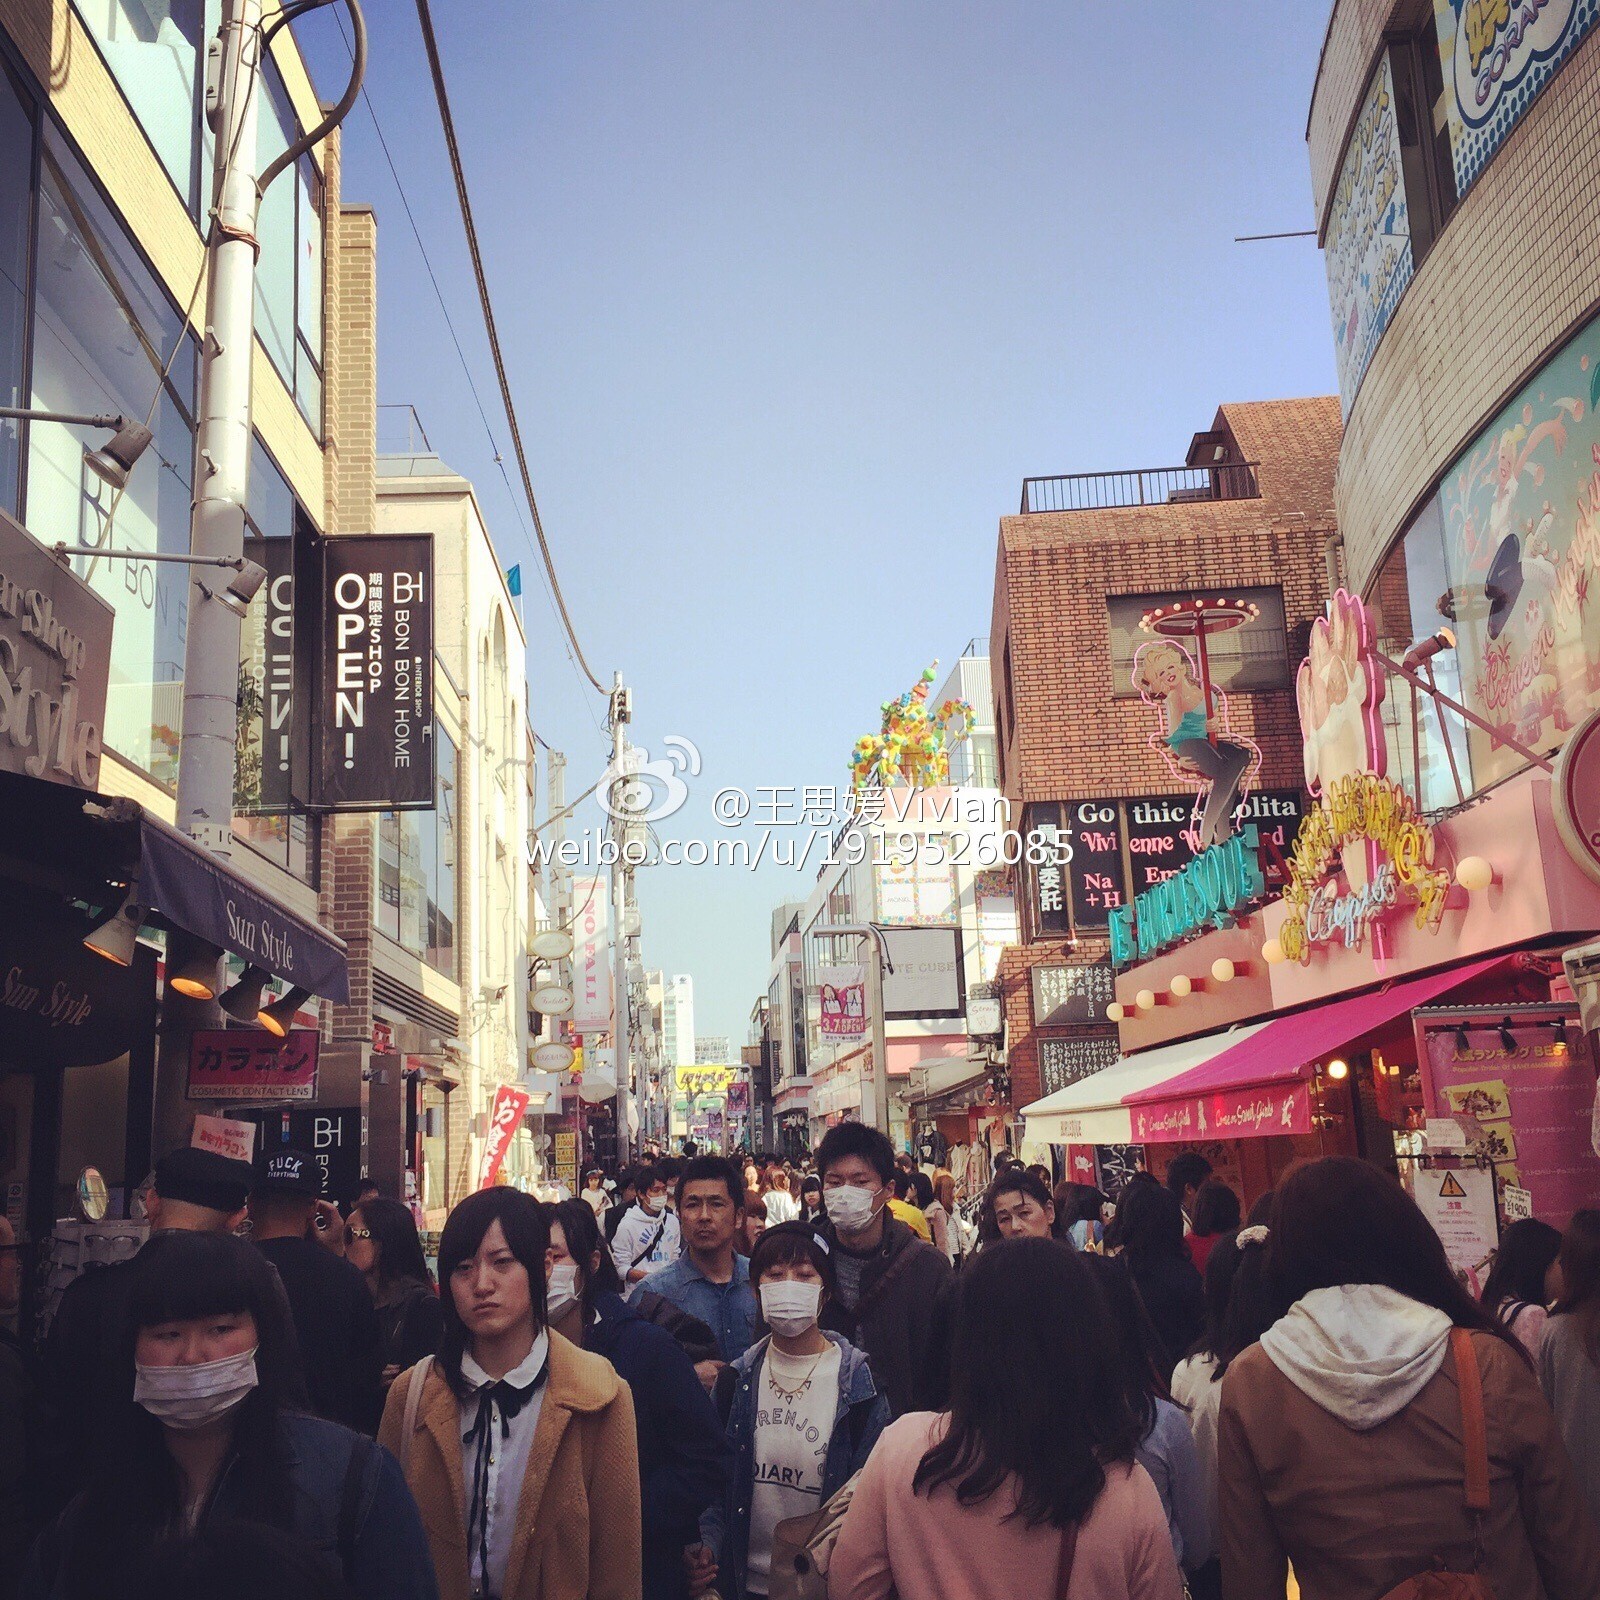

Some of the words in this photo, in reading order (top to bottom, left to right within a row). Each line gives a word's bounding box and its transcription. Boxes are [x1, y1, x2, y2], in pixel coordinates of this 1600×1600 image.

[22, 588, 87, 682] Shop
[395, 610, 410, 651] BON
[335, 572, 367, 769] OPEN!
[395, 660, 410, 701] BON
[415, 699, 423, 718] SHOP
[395, 709, 410, 768] HOME
[227, 900, 256, 952] Sun
[261, 920, 293, 971] Style
[3, 966, 40, 1011] Sun
[40, 981, 91, 1028] Style
[197, 1043, 310, 1071] カラコン
[239, 1086, 282, 1096] CONTACT
[286, 1086, 310, 1096] LENS
[268, 1156, 303, 1173] FUCK
